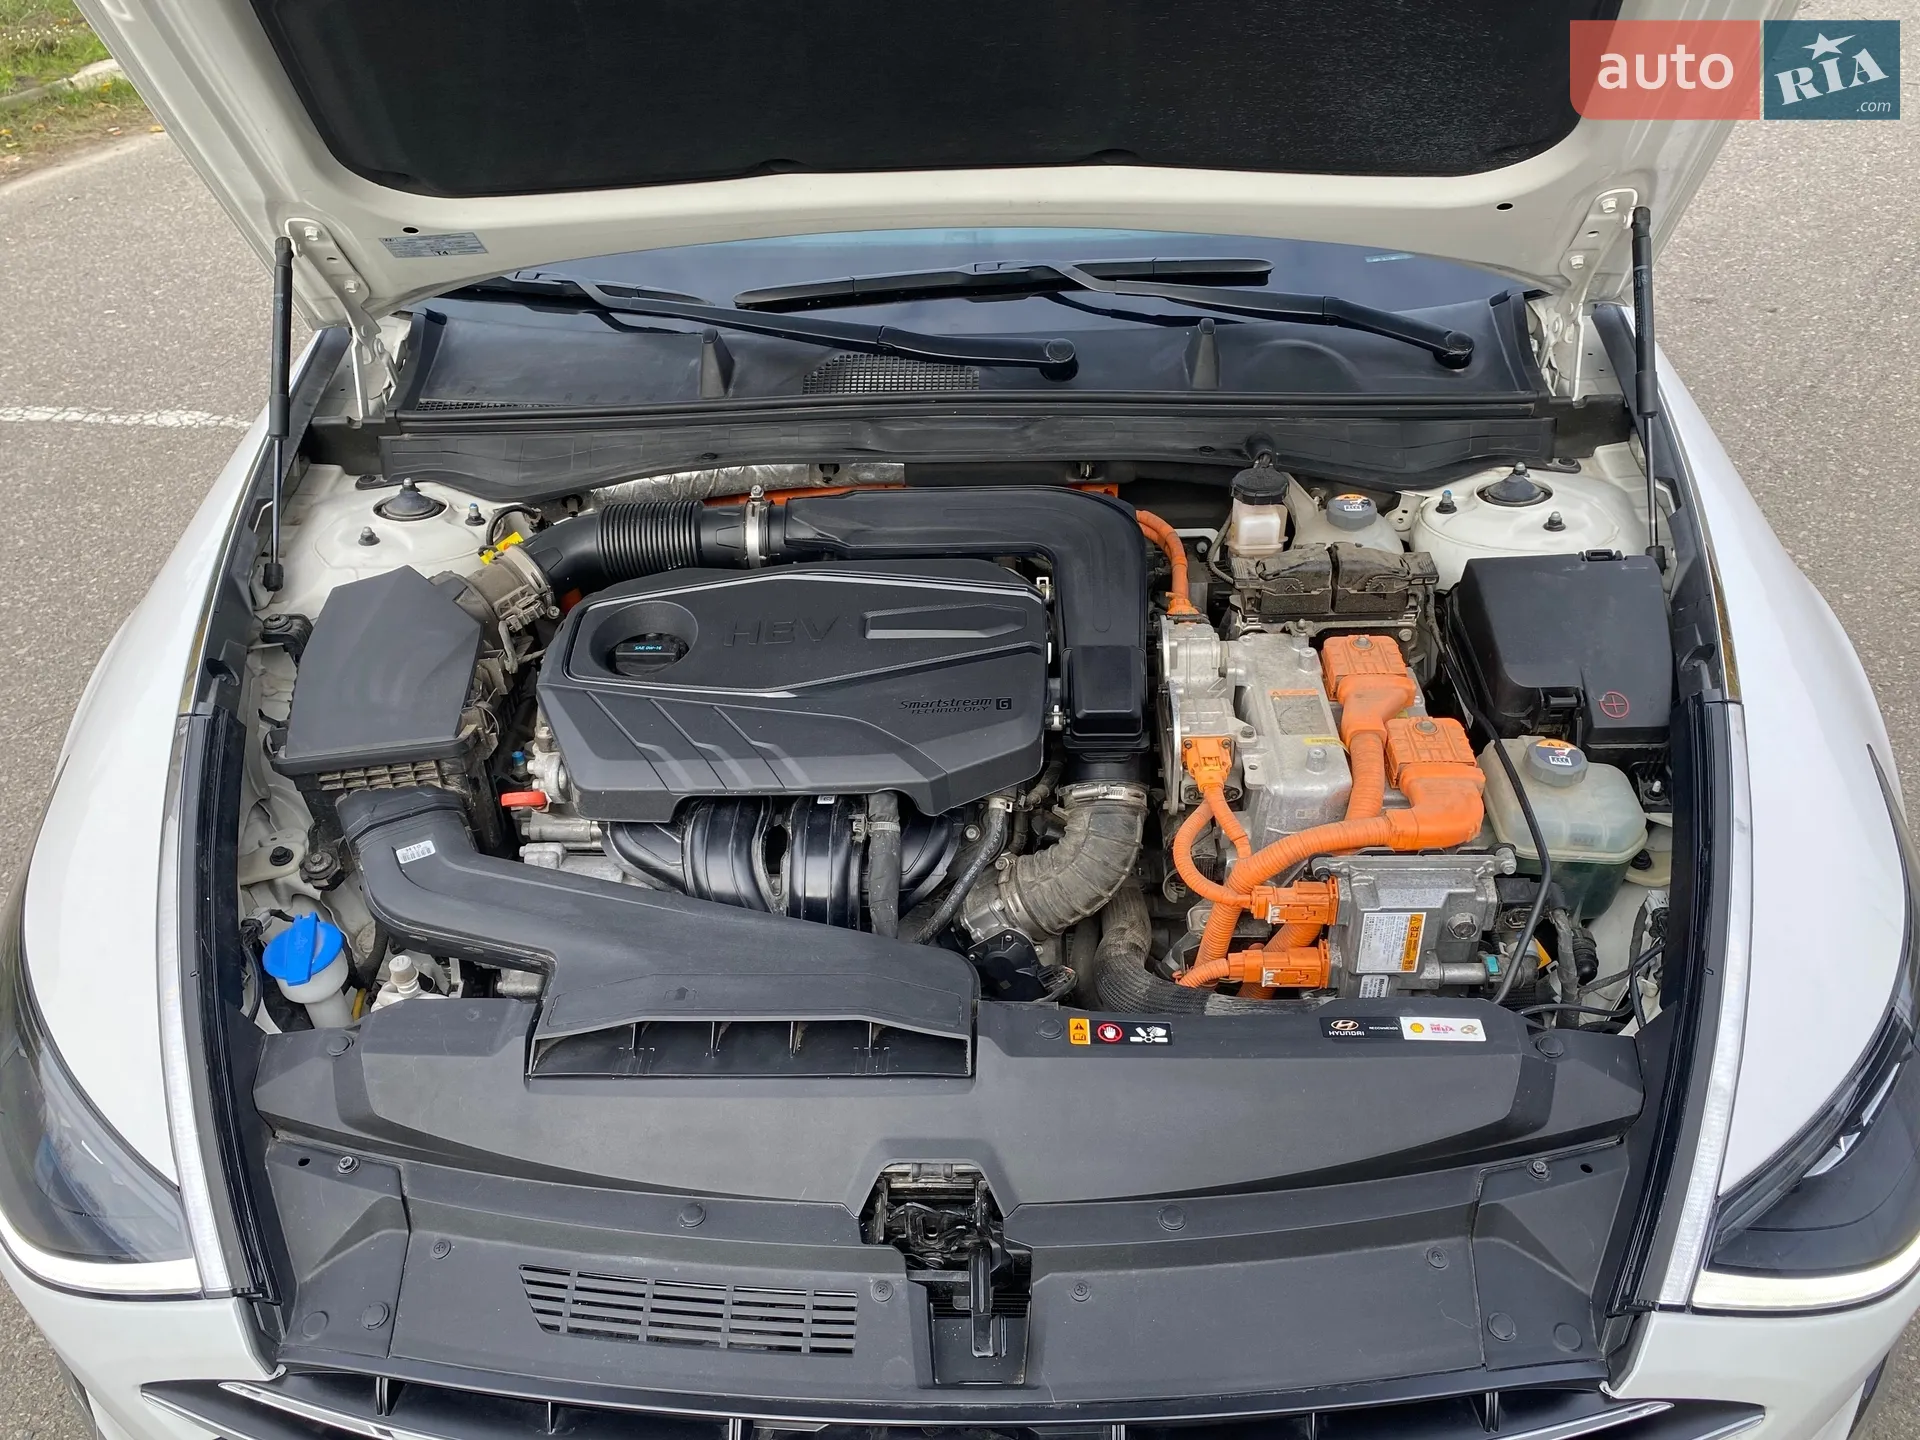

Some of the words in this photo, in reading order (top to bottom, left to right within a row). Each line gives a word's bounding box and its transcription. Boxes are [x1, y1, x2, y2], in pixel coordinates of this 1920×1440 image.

[724, 616, 839, 647] HEV
[898, 698, 992, 710] Smartstream
[911, 706, 989, 715] TECHNOLOGY
